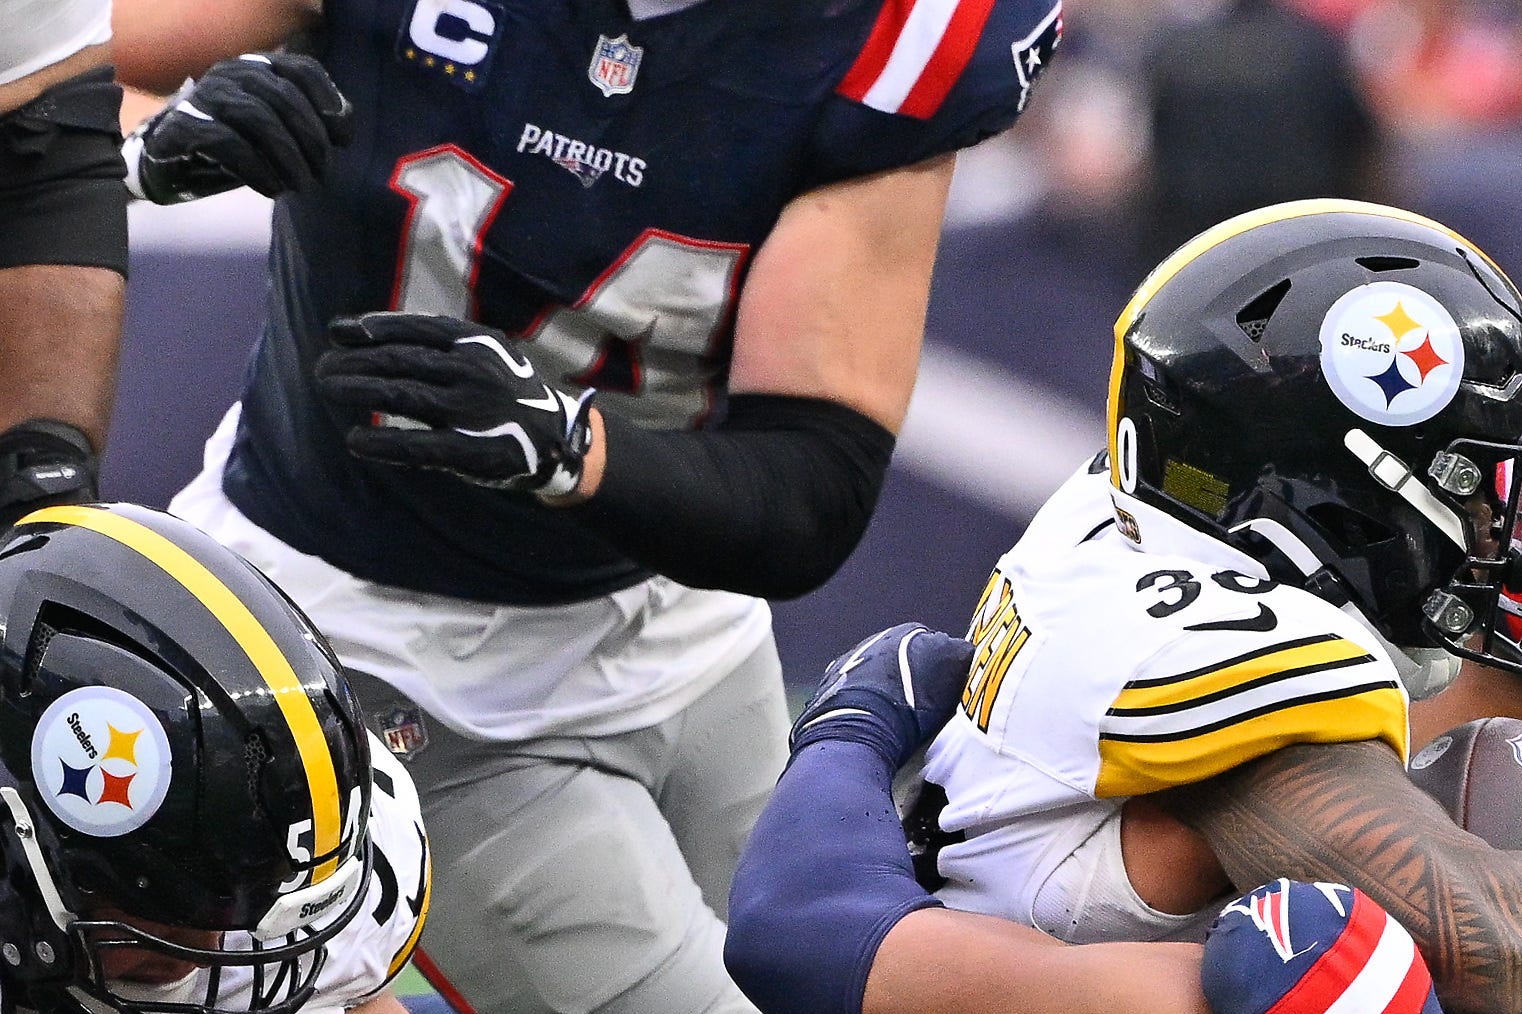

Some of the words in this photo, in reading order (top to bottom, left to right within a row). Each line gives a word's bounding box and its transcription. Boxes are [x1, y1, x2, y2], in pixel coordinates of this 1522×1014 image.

[409, 0, 496, 65] C
[599, 60, 629, 88] NFL
[516, 122, 648, 188] PATRIOTS
[372, 143, 751, 432] 14
[66, 712, 98, 760] Steelers
